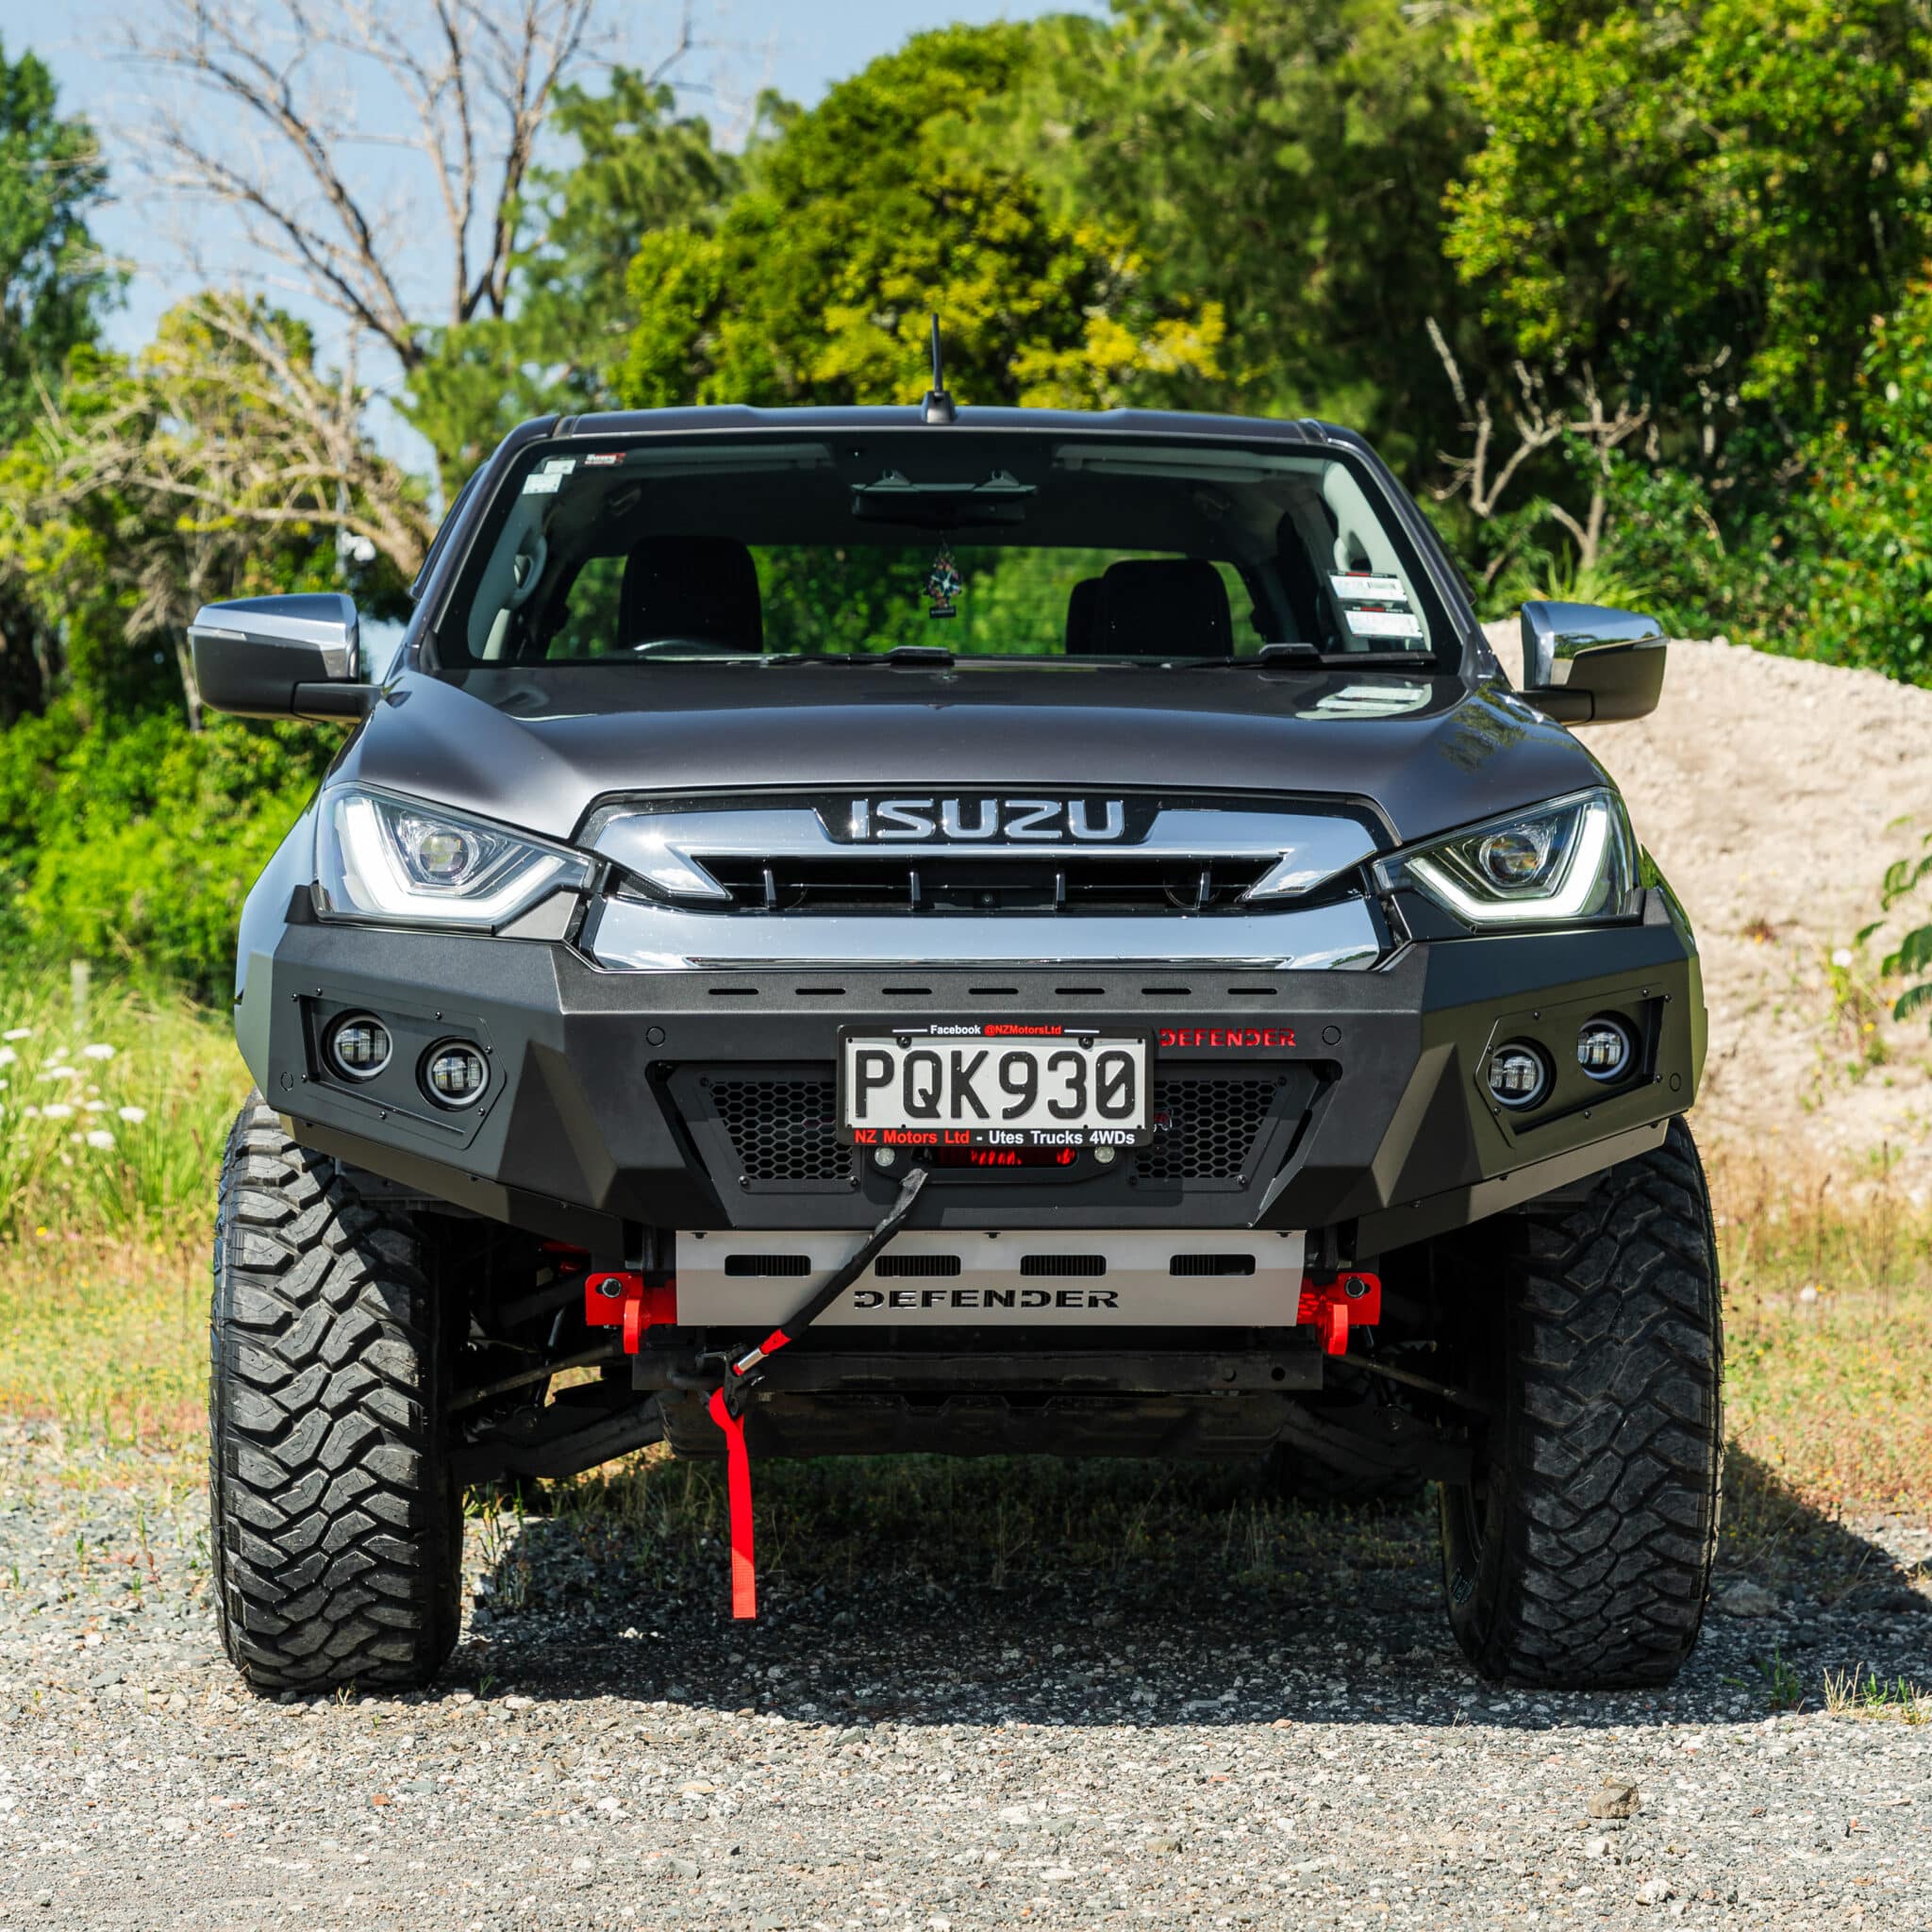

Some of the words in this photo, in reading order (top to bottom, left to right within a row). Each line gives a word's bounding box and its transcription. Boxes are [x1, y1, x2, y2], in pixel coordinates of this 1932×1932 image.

[851, 799, 1125, 839] ISUZU
[930, 1024, 981, 1035] Facebook
[984, 1024, 1062, 1037] @NZMotorsLtd
[1159, 1028, 1296, 1047] DEFENDER
[855, 1049, 1136, 1120] PQK930
[855, 1130, 877, 1143] NZ
[883, 1130, 938, 1143] Motors
[944, 1130, 970, 1143] Ltd
[990, 1130, 1024, 1144] Utes
[1030, 1130, 1083, 1144] Trucks
[1089, 1130, 1136, 1144] 4WDs
[854, 1290, 1120, 1308] DEFENDER
